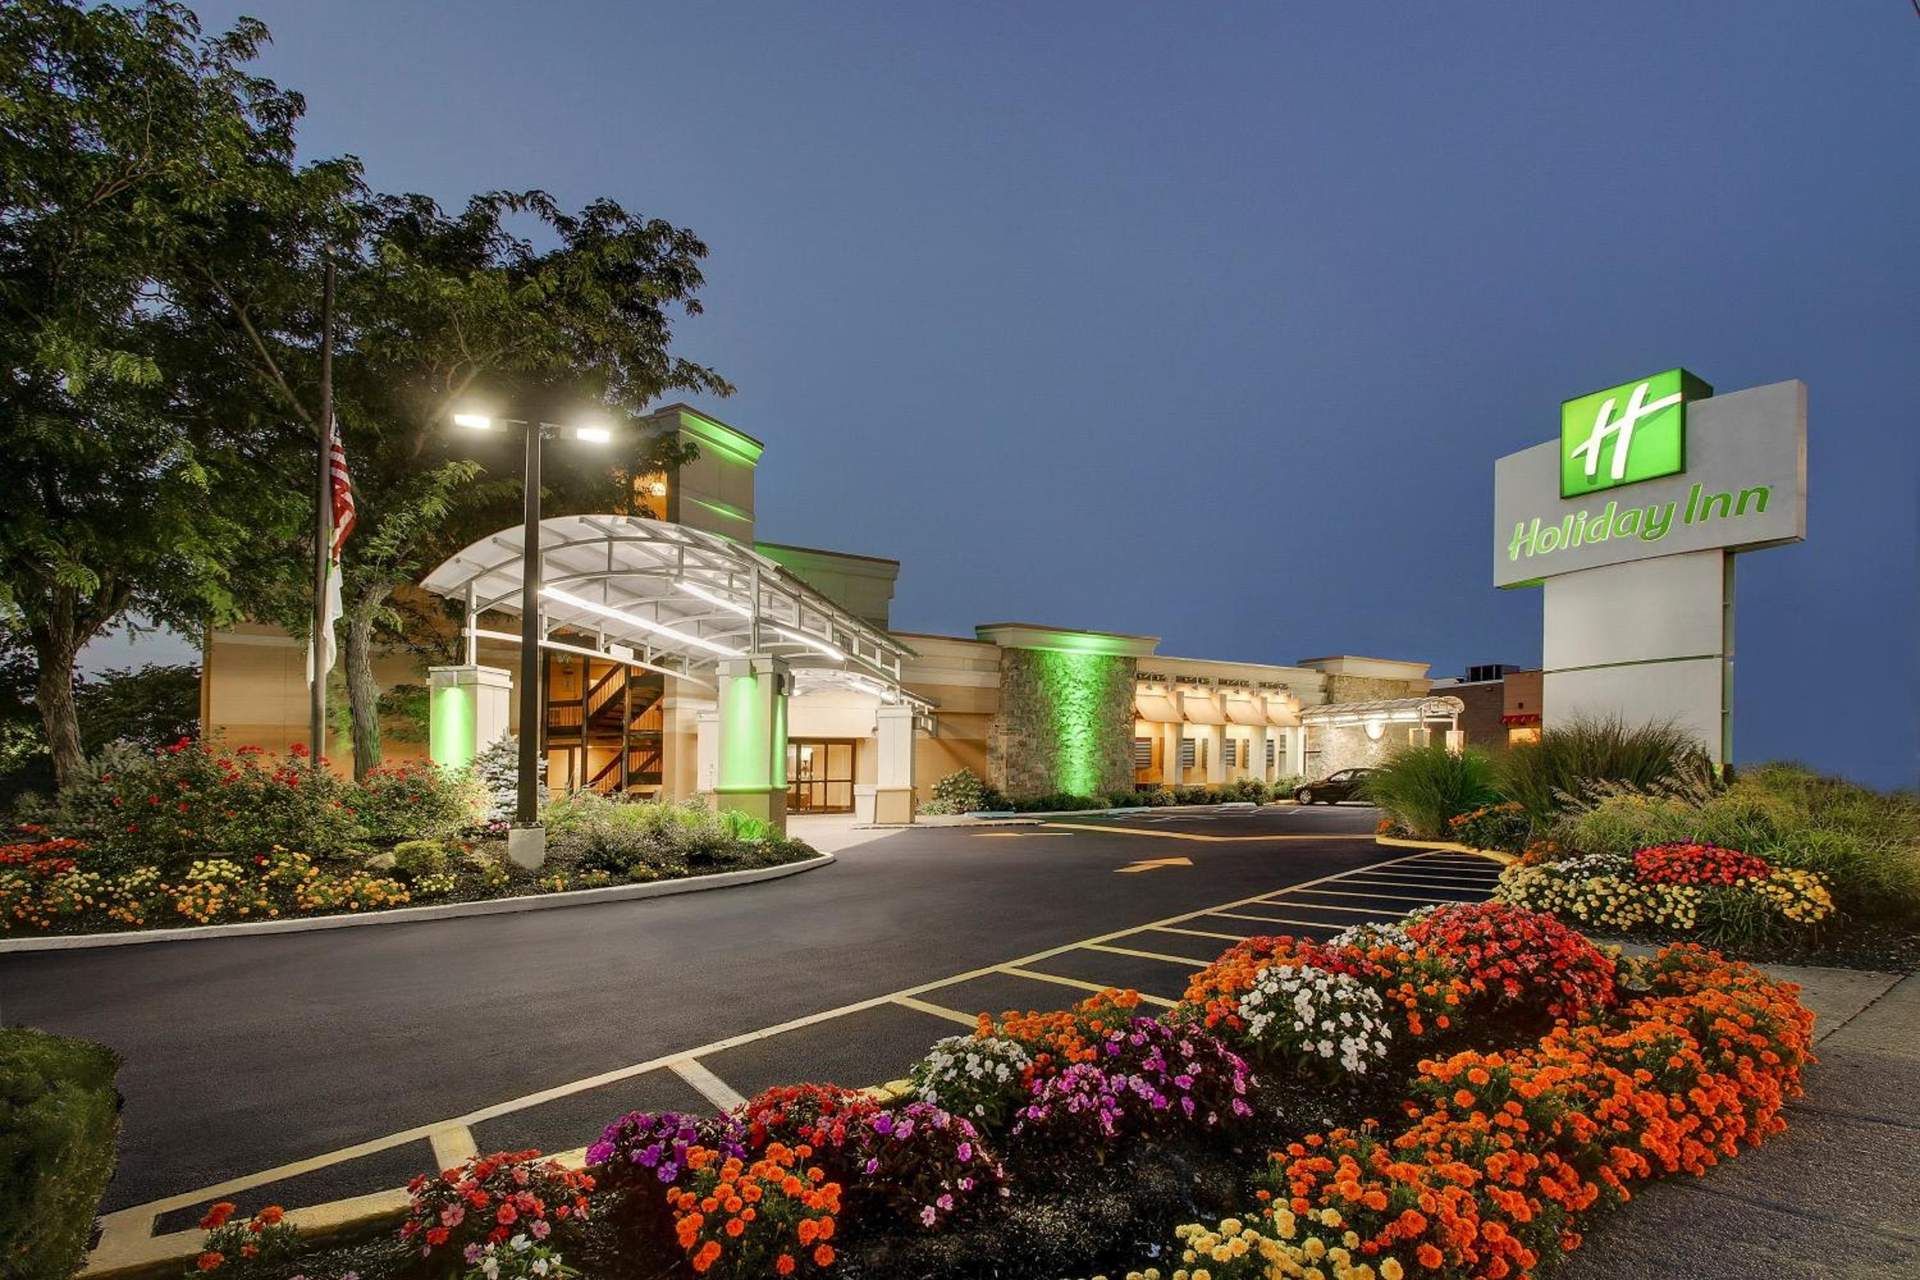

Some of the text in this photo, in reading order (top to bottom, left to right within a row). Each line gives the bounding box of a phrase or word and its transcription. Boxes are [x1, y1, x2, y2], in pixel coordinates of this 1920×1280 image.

[1571, 382, 1682, 480] H
[1508, 482, 1770, 561] Holiday Inn
